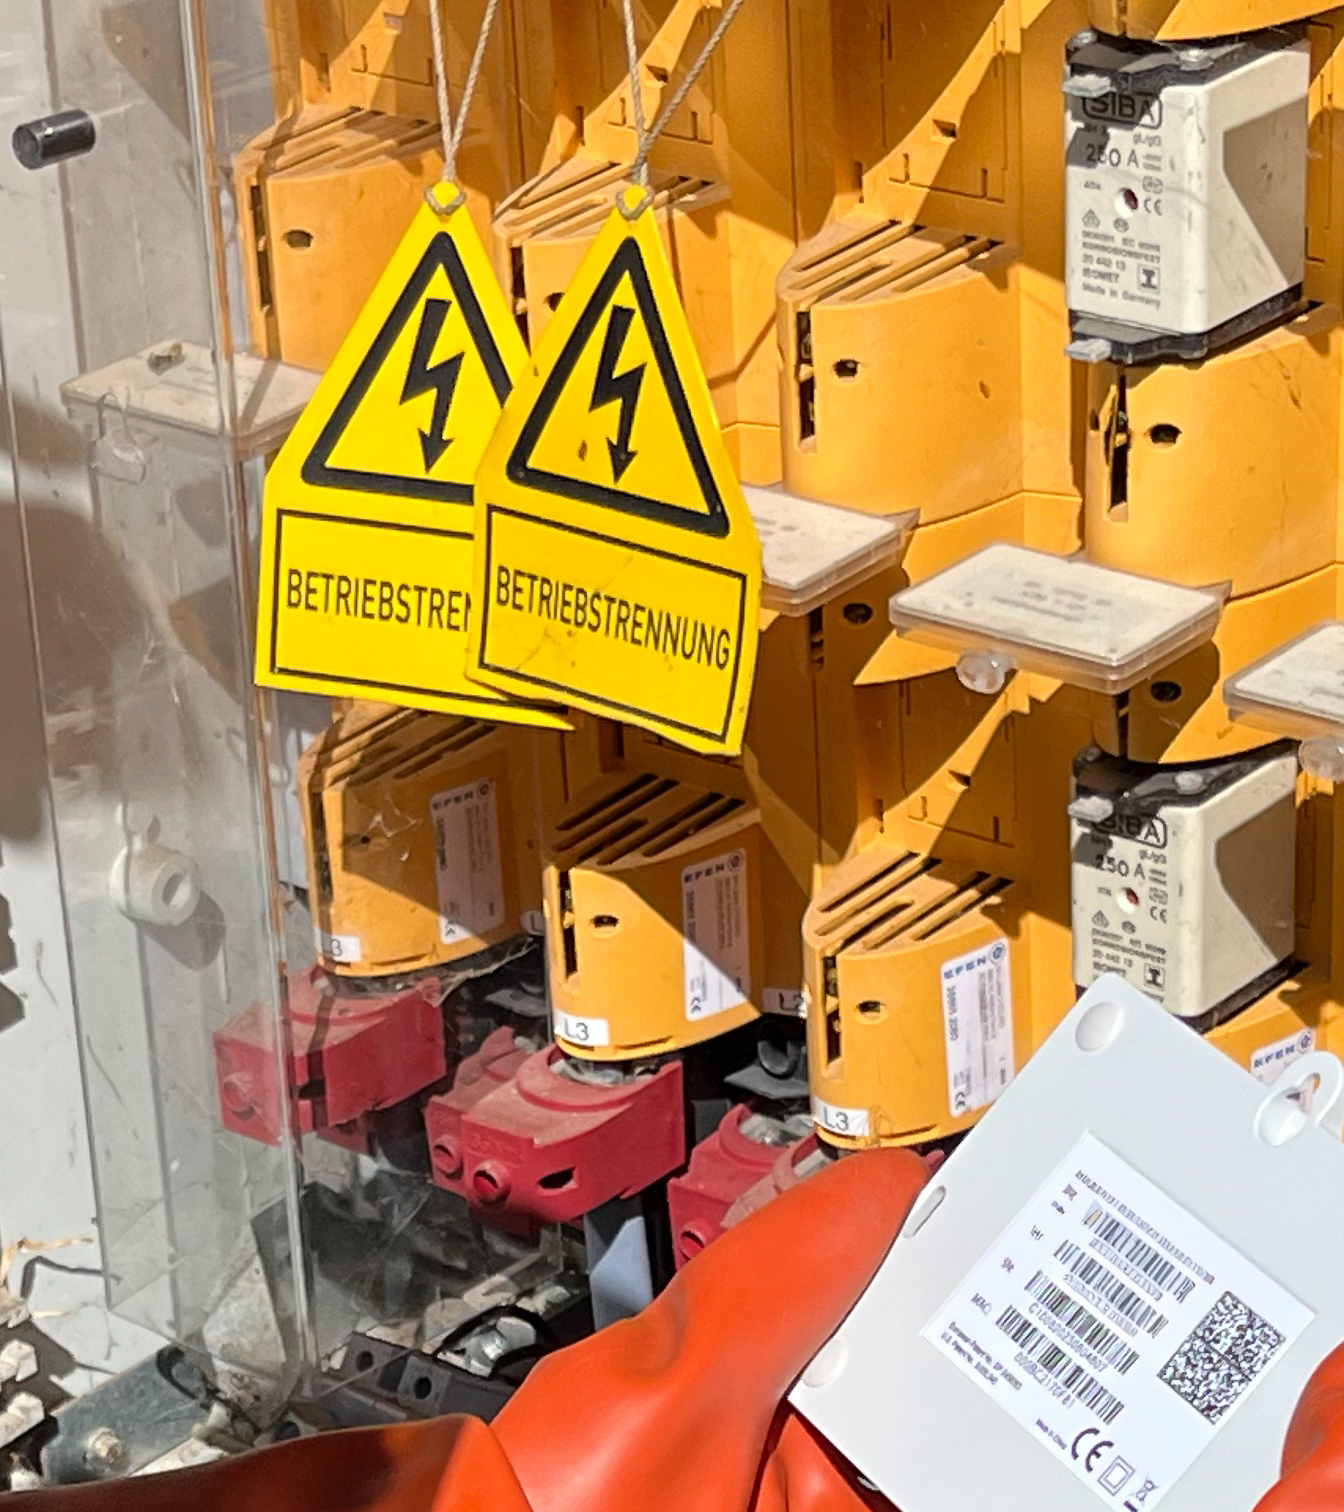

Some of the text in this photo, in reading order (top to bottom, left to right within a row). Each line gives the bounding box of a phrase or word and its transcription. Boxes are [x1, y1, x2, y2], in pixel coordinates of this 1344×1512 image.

[1089, 91, 1156, 123] SIBA
[1085, 143, 1122, 169] 250
[1126, 148, 1140, 169] A
[495, 564, 732, 670] BETRIEBSTRENNUNG
[1094, 853, 1130, 878] 250
[1133, 862, 1146, 881] A
[562, 1020, 591, 1042] L3
[821, 1106, 850, 1132] L3
[1070, 1427, 1115, 1474] CE
